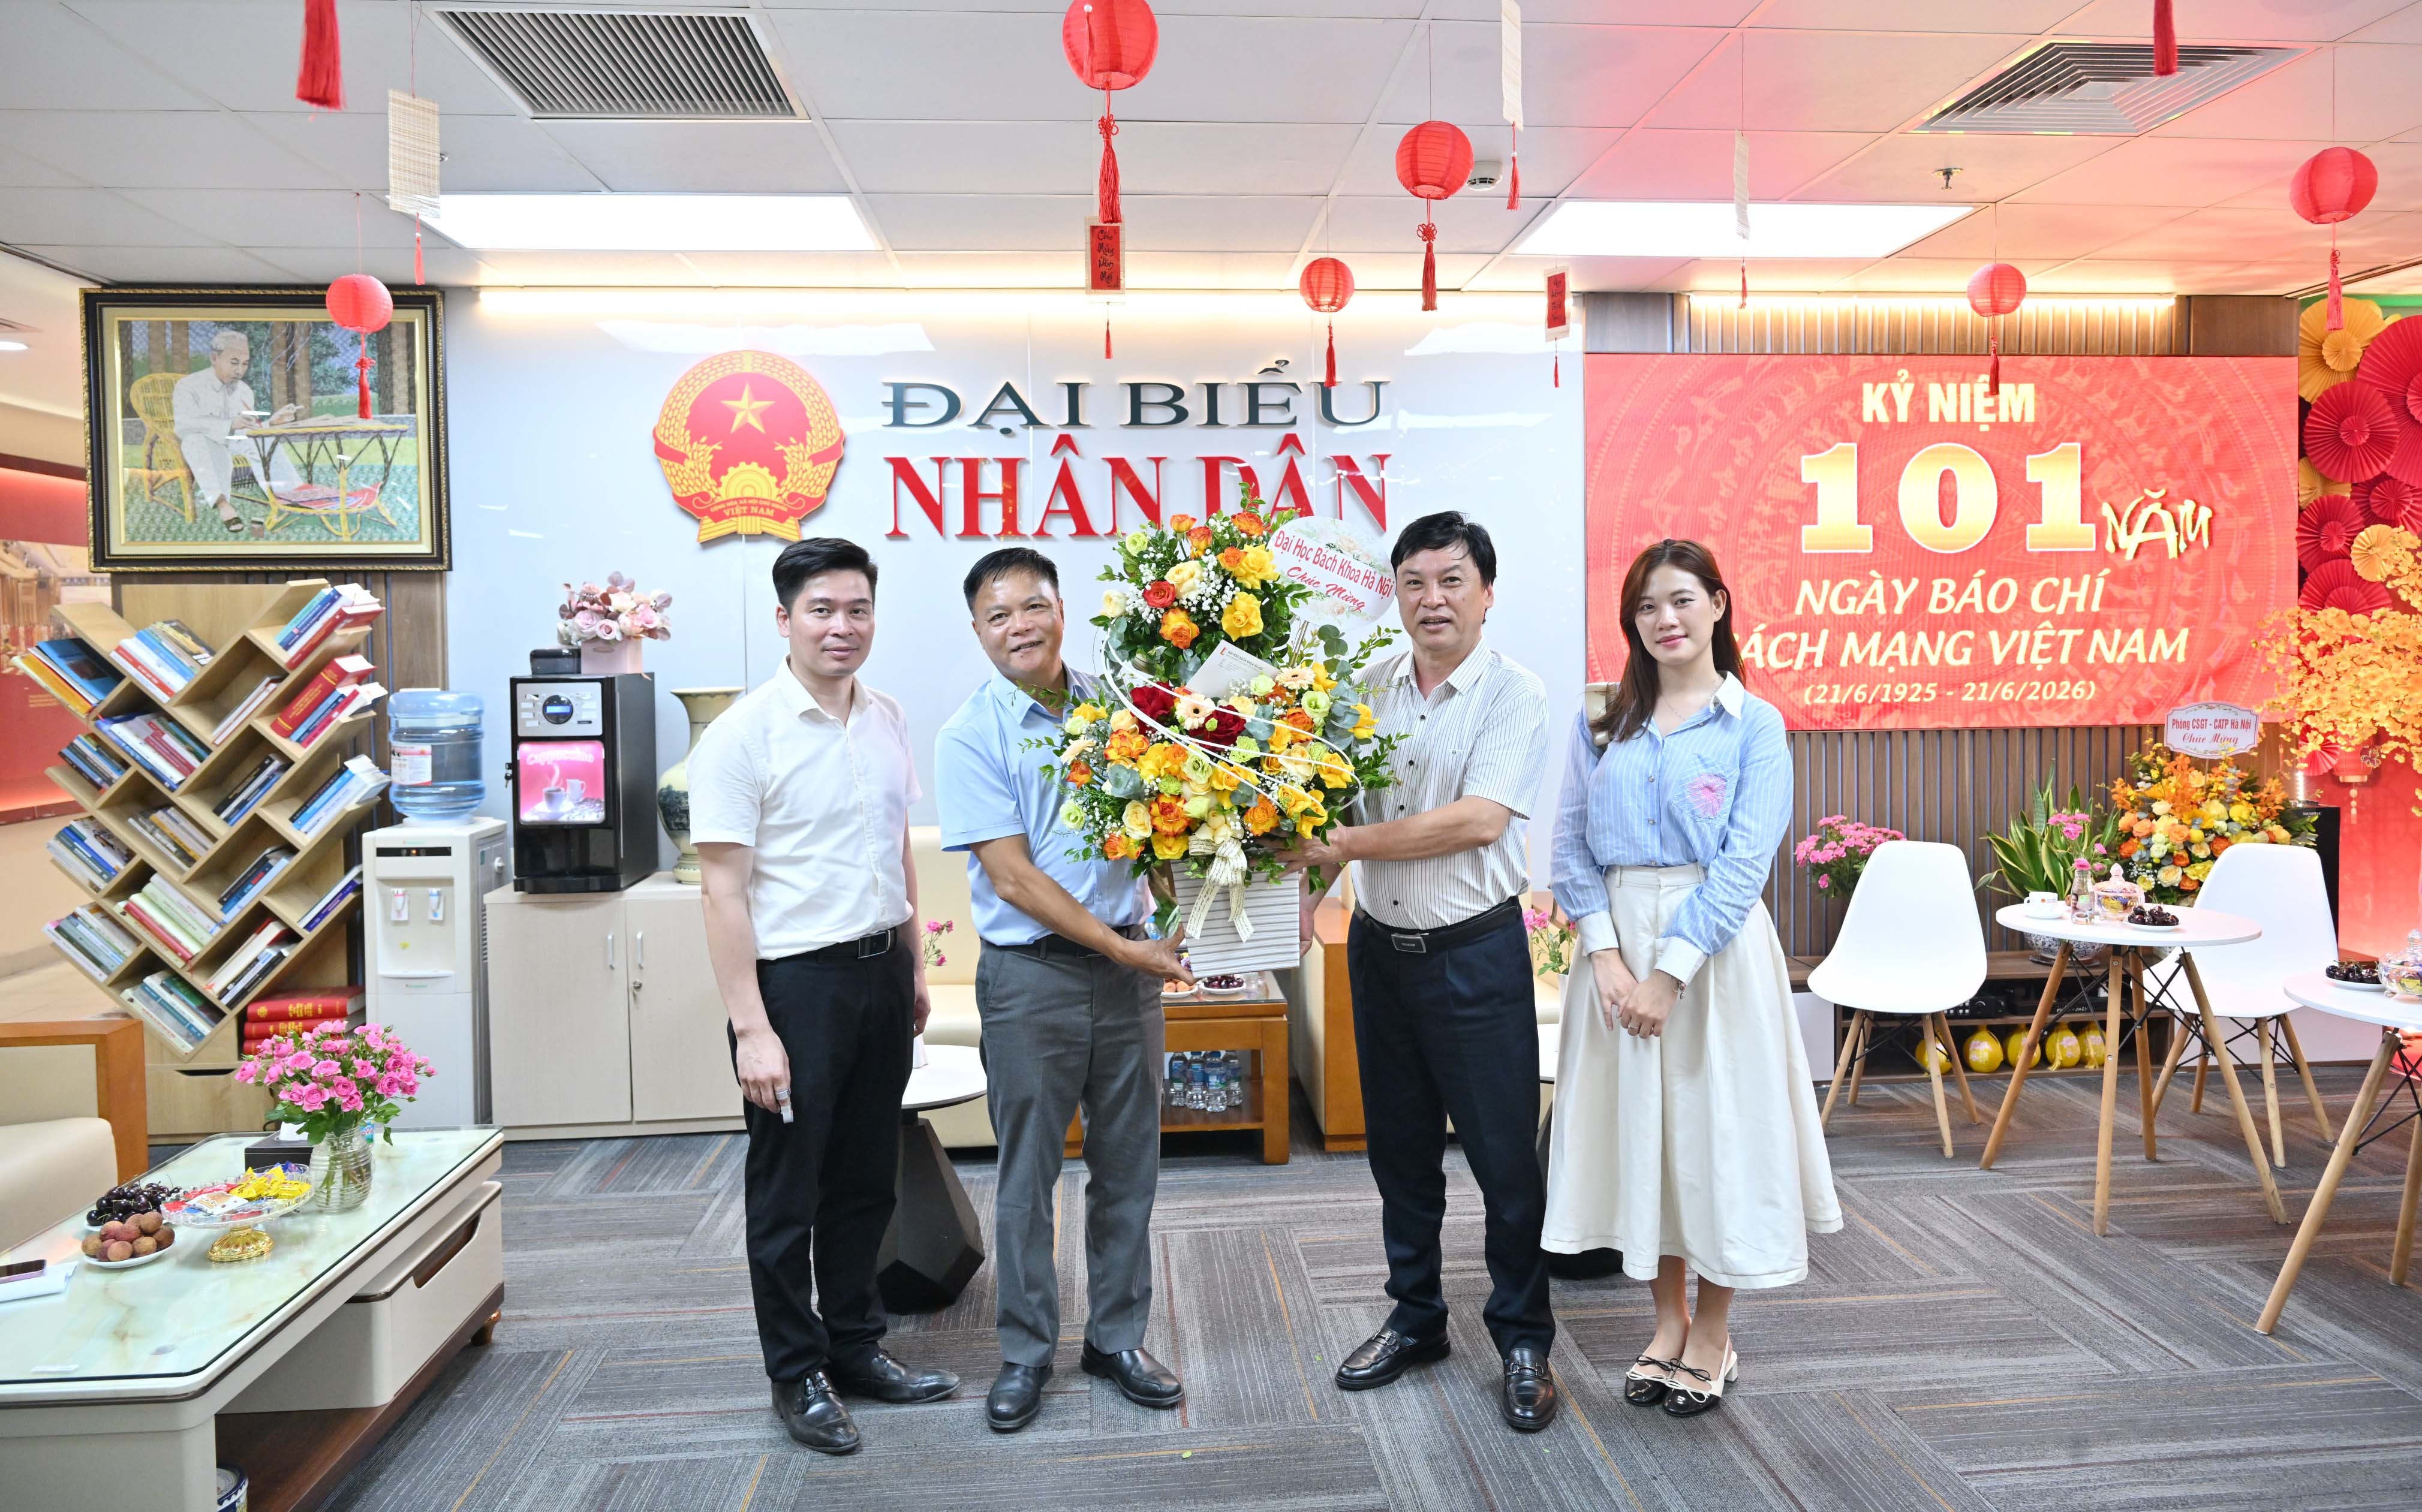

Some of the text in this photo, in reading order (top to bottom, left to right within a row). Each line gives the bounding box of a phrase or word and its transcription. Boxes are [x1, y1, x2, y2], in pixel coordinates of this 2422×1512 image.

[881, 359, 1391, 435] ĐẠI BIỂU
[1863, 369, 2035, 432] KỶ NIỆM
[883, 433, 1392, 537] NHÂN DÂN
[1801, 442, 2213, 561] 101 NĂM
[723, 504, 775, 517] VIỆT NAM
[1274, 530, 1395, 600] Đại Học Bách Khoa Hà Nội
[1287, 567, 1365, 613] Chúc Mừng
[1795, 568, 2111, 615] NGÀY BÁO CHÍ
[1735, 620, 2189, 673] ÁCH MẠNG VIỆT NAM
[1804, 682, 1938, 705] (21/6/1925
[1961, 680, 2096, 702] 21/6/2026)
[2172, 718, 2190, 730] Phòng
[2192, 719, 2208, 729] CSGT
[2213, 719, 2229, 729] CATP
[2230, 719, 2239, 729] Hà
[2240, 718, 2251, 732] Nội
[2183, 733, 2239, 745] Chúc Mừng
[526, 747, 595, 766] Cappuccino
